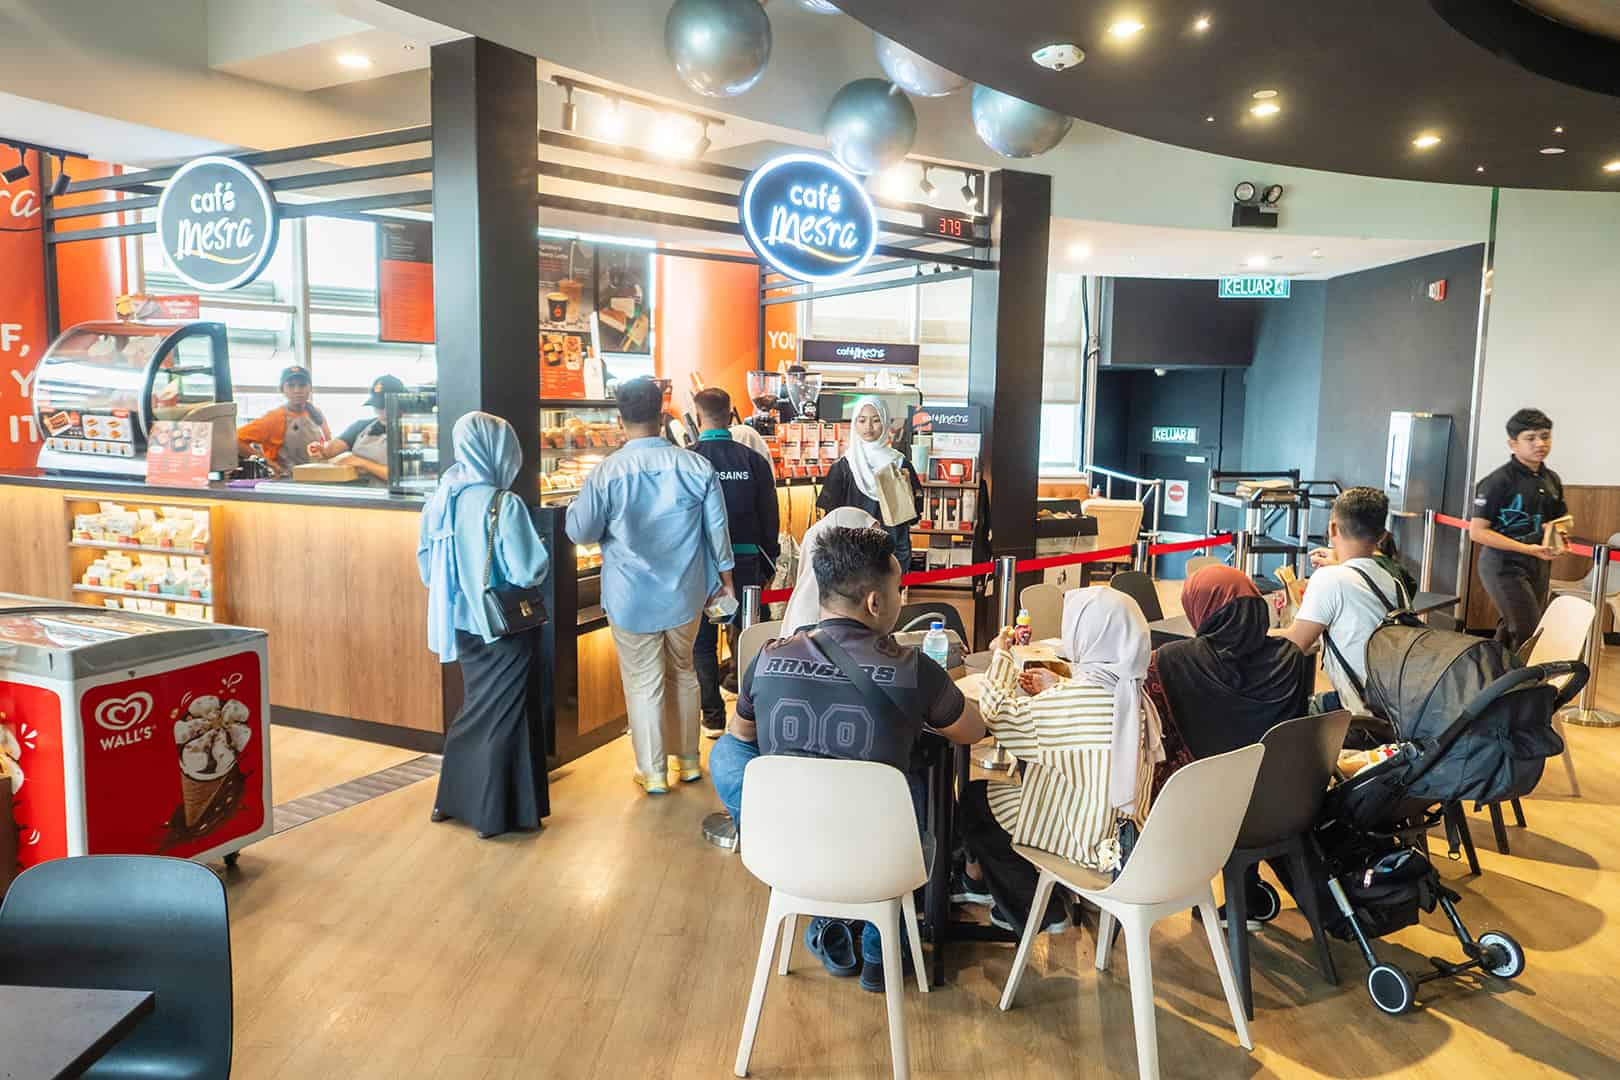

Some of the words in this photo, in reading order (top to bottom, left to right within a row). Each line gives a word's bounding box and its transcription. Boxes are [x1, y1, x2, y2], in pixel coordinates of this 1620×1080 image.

[190, 182, 236, 214] café
[790, 184, 842, 213] café
[938, 217, 962, 237] 379
[1224, 277, 1274, 296] KELUAR
[1155, 428, 1188, 441] KELUAR
[100, 726, 152, 751] WALL'S
